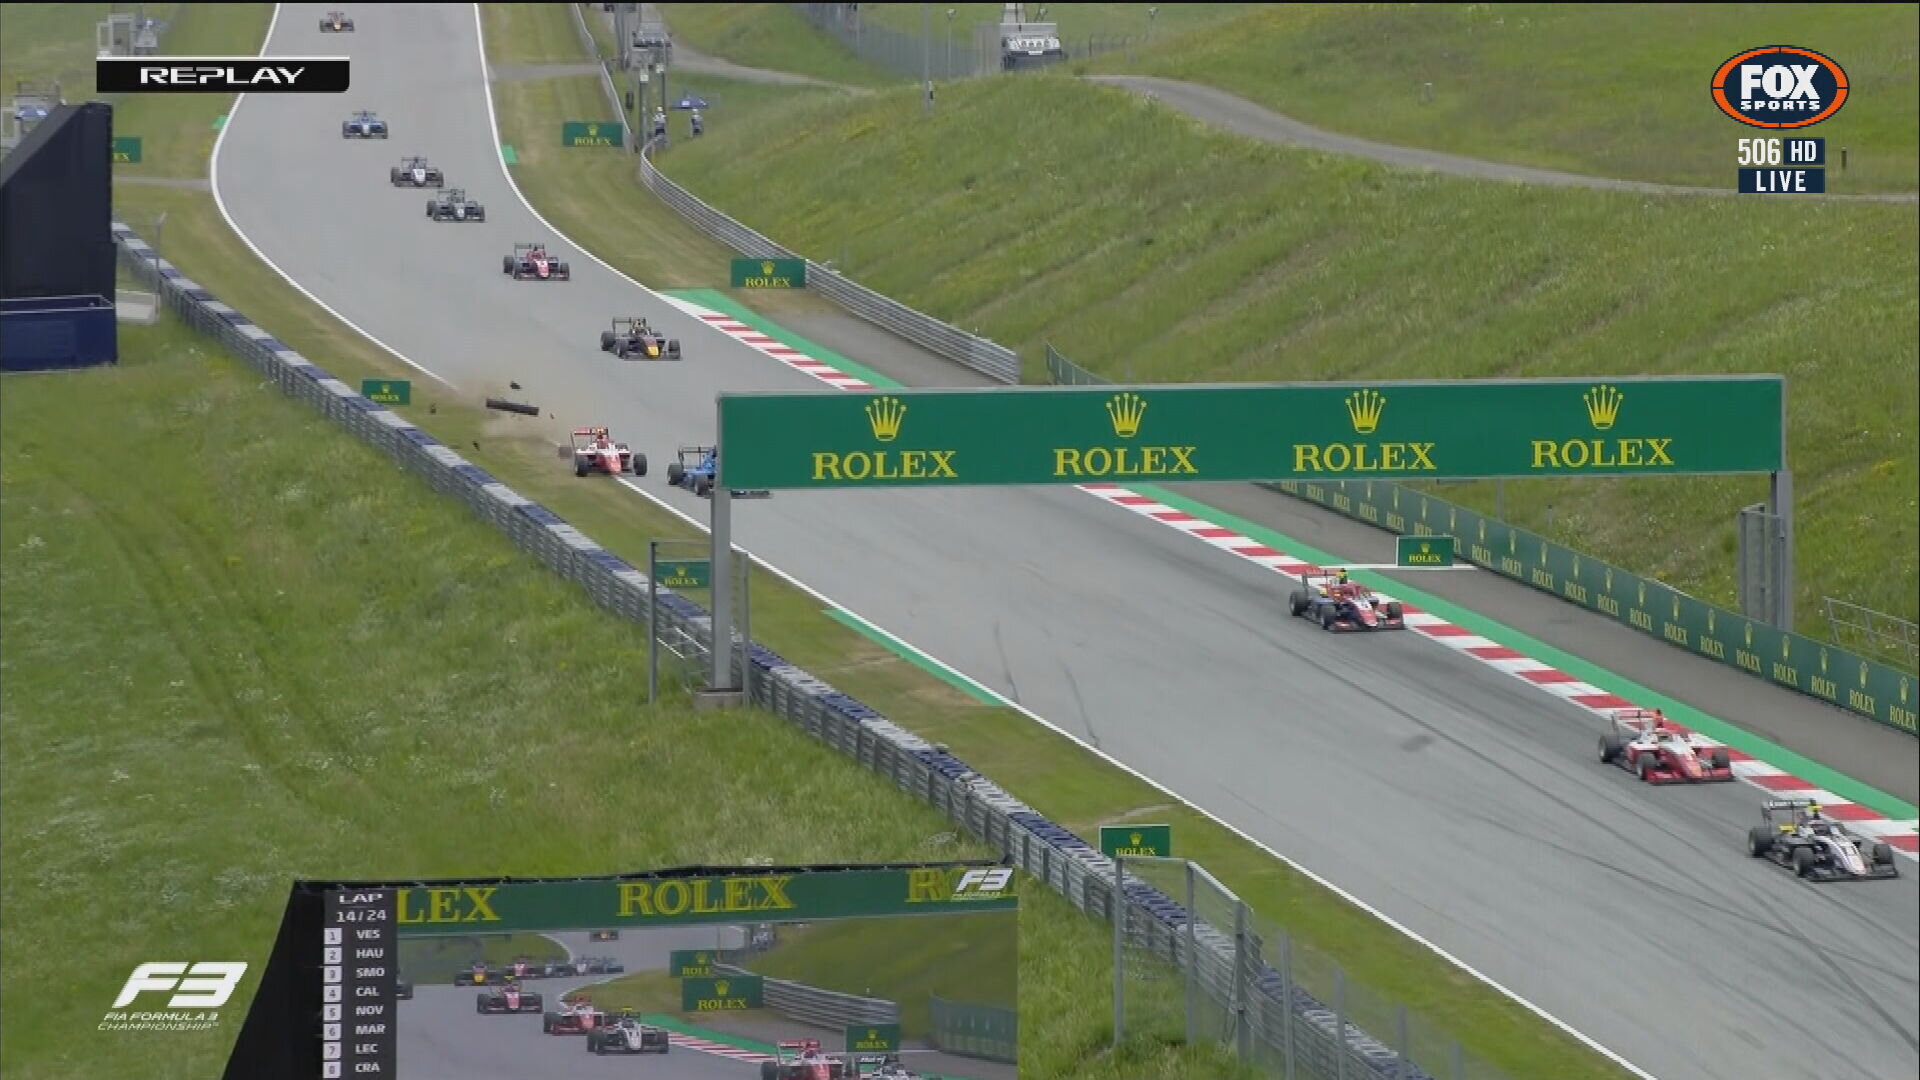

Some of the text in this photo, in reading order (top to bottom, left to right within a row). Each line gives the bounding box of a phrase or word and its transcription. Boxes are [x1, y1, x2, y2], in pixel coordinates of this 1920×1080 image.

[745, 276, 791, 288] ROLEX
[812, 450, 959, 479] ROLEX
[1053, 446, 1199, 476] ROLEX
[1292, 442, 1437, 472] ROLEX
[1531, 438, 1674, 468] ROLEX
[1408, 553, 1440, 563] ROLEX
[1598, 593, 1619, 617] ROLEX
[1630, 607, 1652, 632] ROLEX
[1664, 621, 1688, 647] ROLEX
[1700, 634, 1724, 660] ROLEX
[1736, 647, 1761, 673] ROLEX
[1773, 661, 1798, 687] ROLEX
[1811, 675, 1837, 700] ROLEX
[1849, 688, 1875, 715] ROLEX
[1889, 703, 1917, 731] ROLEX
[1115, 847, 1156, 857] ROLEX
[956, 869, 1013, 892] F3
[339, 893, 383, 904] LAP
[397, 887, 501, 922] LEX
[616, 875, 795, 917] ROLEX
[336, 909, 387, 923] 14/24
[329, 929, 381, 941] 1 VES
[329, 948, 384, 961] 2 HAU
[356, 967, 385, 978] SMO
[329, 986, 380, 999] 4 CAL
[329, 1005, 384, 1018] 5 NOV
[698, 999, 746, 1010] ROLEX
[329, 1024, 386, 1037] 6 MAR
[329, 1043, 379, 1055] 7 LEC
[355, 1063, 380, 1073] CRA
